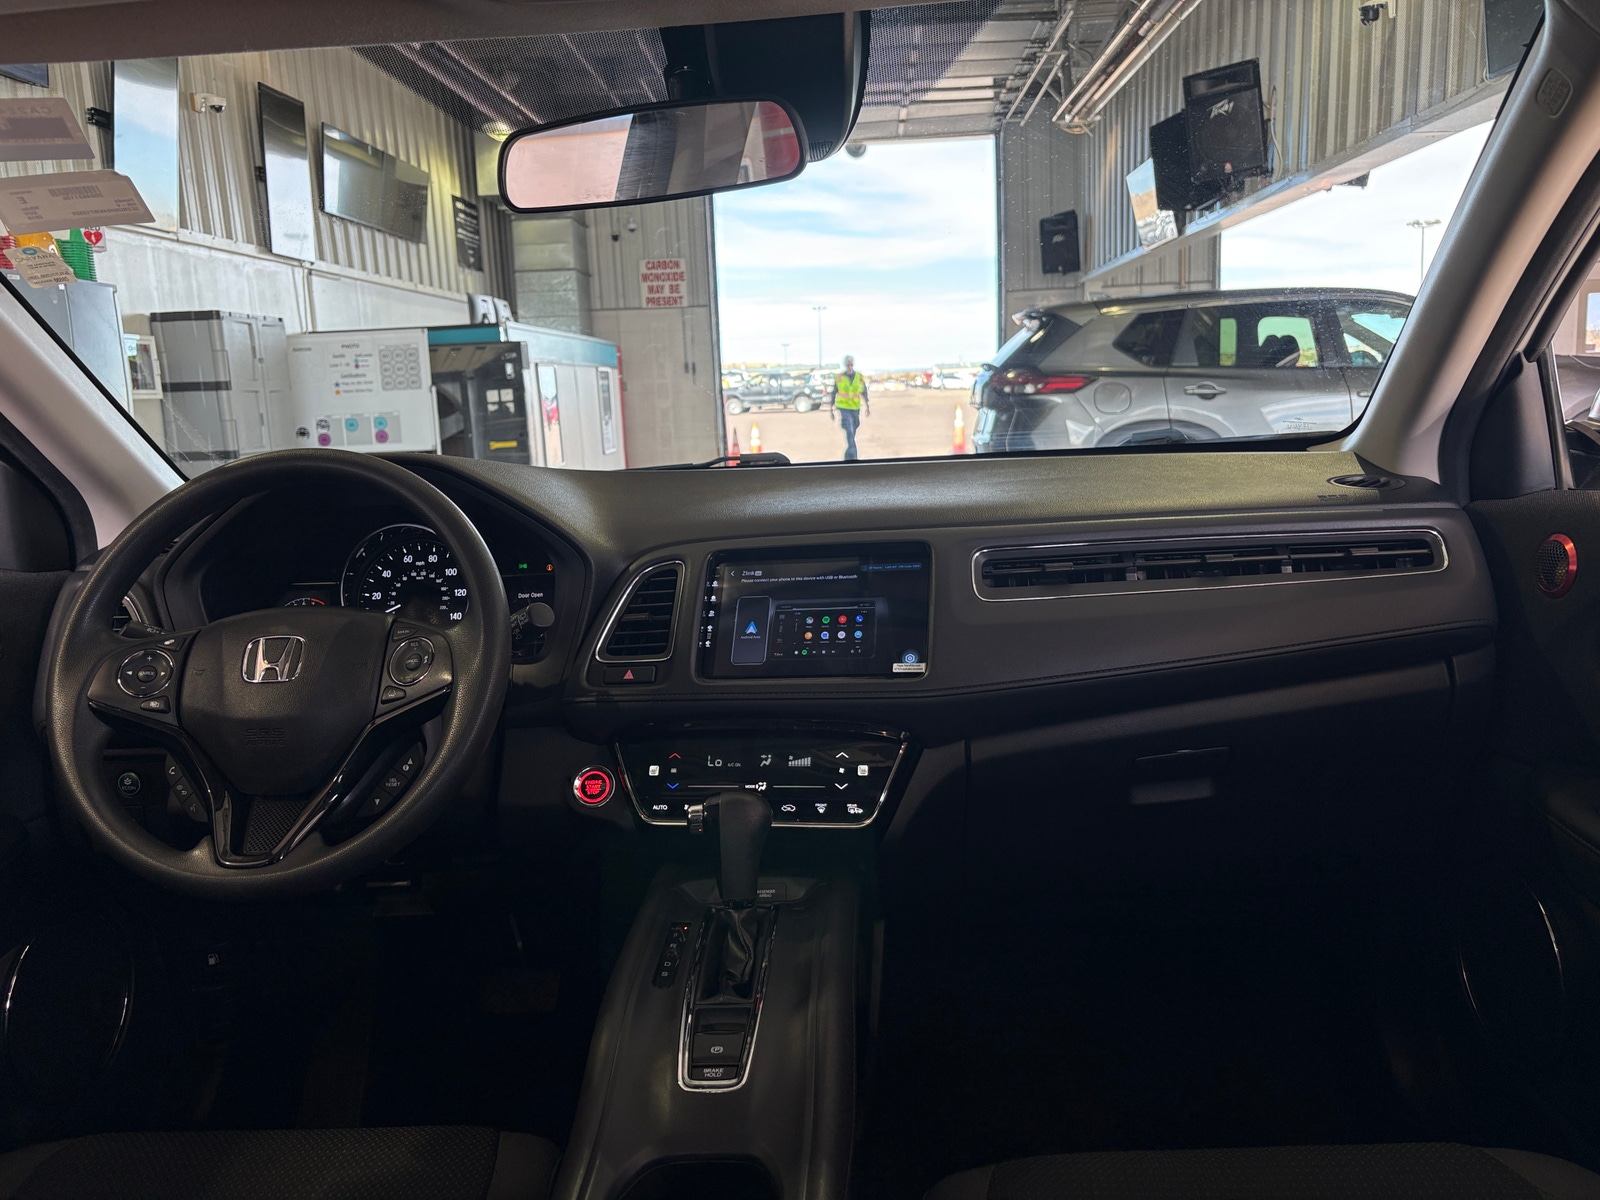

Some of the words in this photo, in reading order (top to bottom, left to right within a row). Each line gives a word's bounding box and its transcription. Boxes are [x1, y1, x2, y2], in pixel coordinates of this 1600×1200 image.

[645, 260, 681, 271] CARBON
[641, 271, 686, 283] MONOXIDE
[647, 284, 665, 295] MAY
[669, 284, 681, 294] BE
[645, 296, 684, 307] PRESENT
[403, 555, 413, 563] 60
[428, 555, 438, 563] 80
[382, 570, 392, 578] 40
[445, 568, 458, 576] 100
[371, 592, 382, 600] 20
[454, 588, 467, 597] 120
[450, 612, 463, 621] 140
[707, 755, 723, 767] Lo
